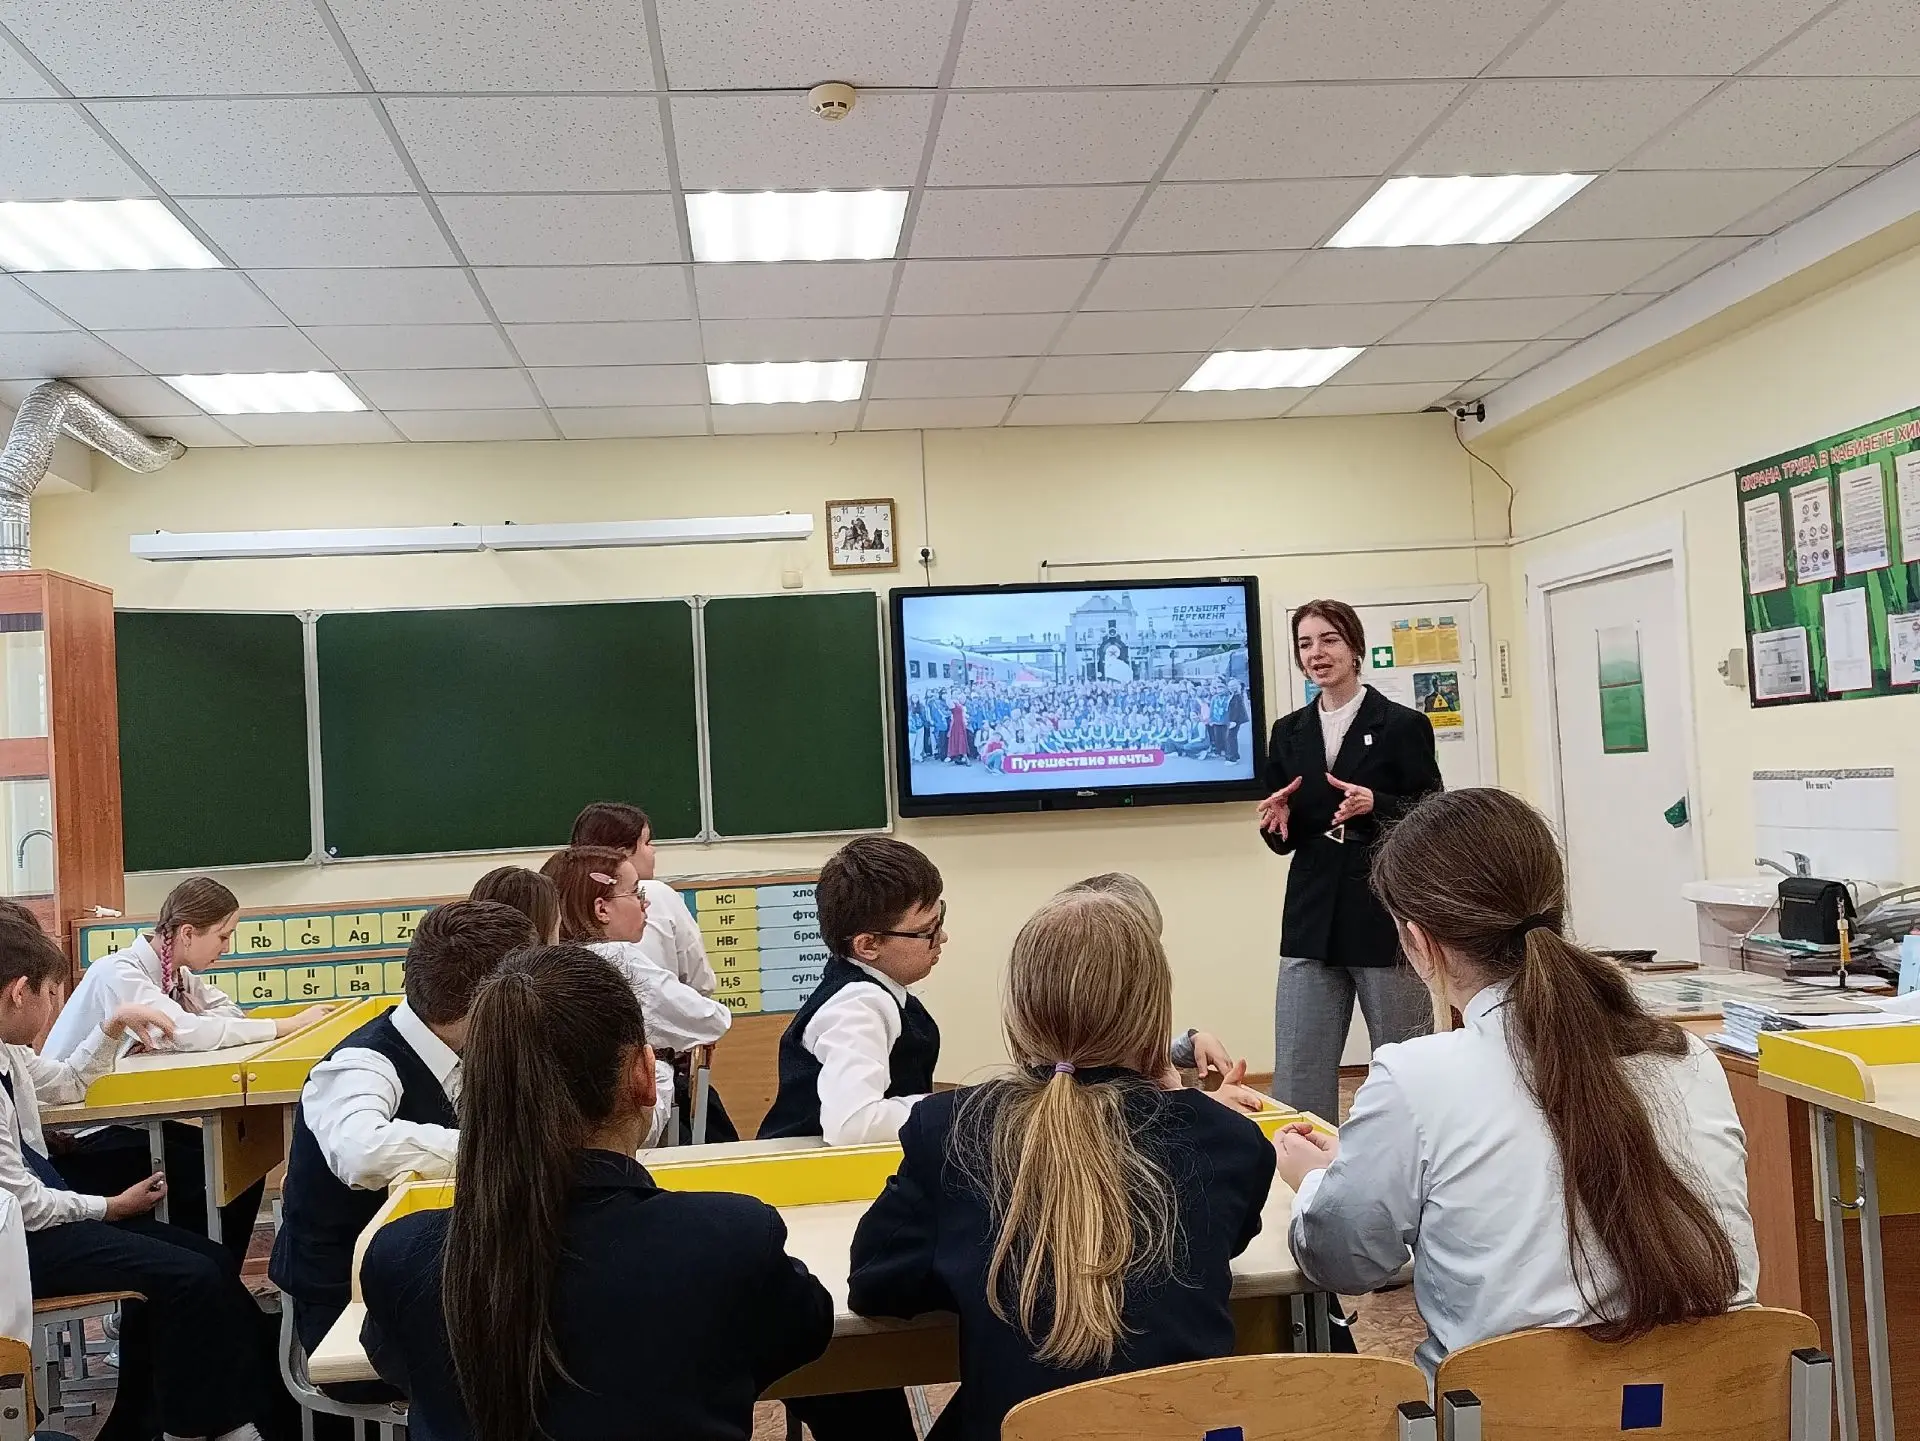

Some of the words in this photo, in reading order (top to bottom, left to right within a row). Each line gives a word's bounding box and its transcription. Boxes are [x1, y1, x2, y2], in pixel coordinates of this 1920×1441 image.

[1740, 466, 1782, 493] ОХРАНА
[1782, 454, 1818, 480] ТРУДА
[1818, 450, 1829, 467] В
[1829, 430, 1896, 464] КАБИНЕТЕ
[841, 506, 849, 514] 11
[856, 506, 865, 514] 12
[874, 505, 878, 514] 1
[833, 515, 842, 523] 10
[883, 513, 889, 521] 2
[833, 531, 839, 539] 9
[844, 555, 850, 563] 7
[860, 555, 865, 563] 6
[876, 554, 881, 562] 5
[1173, 604, 1227, 614] БОЛЬШАЯ
[1172, 612, 1225, 621] ПЕРЕМЕНА
[1011, 755, 1106, 772] Путешествие
[1108, 753, 1155, 766] мечты
[715, 894, 736, 905] HCl
[719, 915, 736, 925] HF
[348, 930, 370, 943] Ag
[397, 926, 415, 939] Zn
[251, 936, 272, 949] Rb
[300, 933, 320, 945] Cs
[716, 936, 739, 947] HBr
[724, 957, 736, 967] HI
[302, 983, 320, 995] Sr
[350, 980, 370, 992] Ba
[252, 986, 273, 998] Ca
